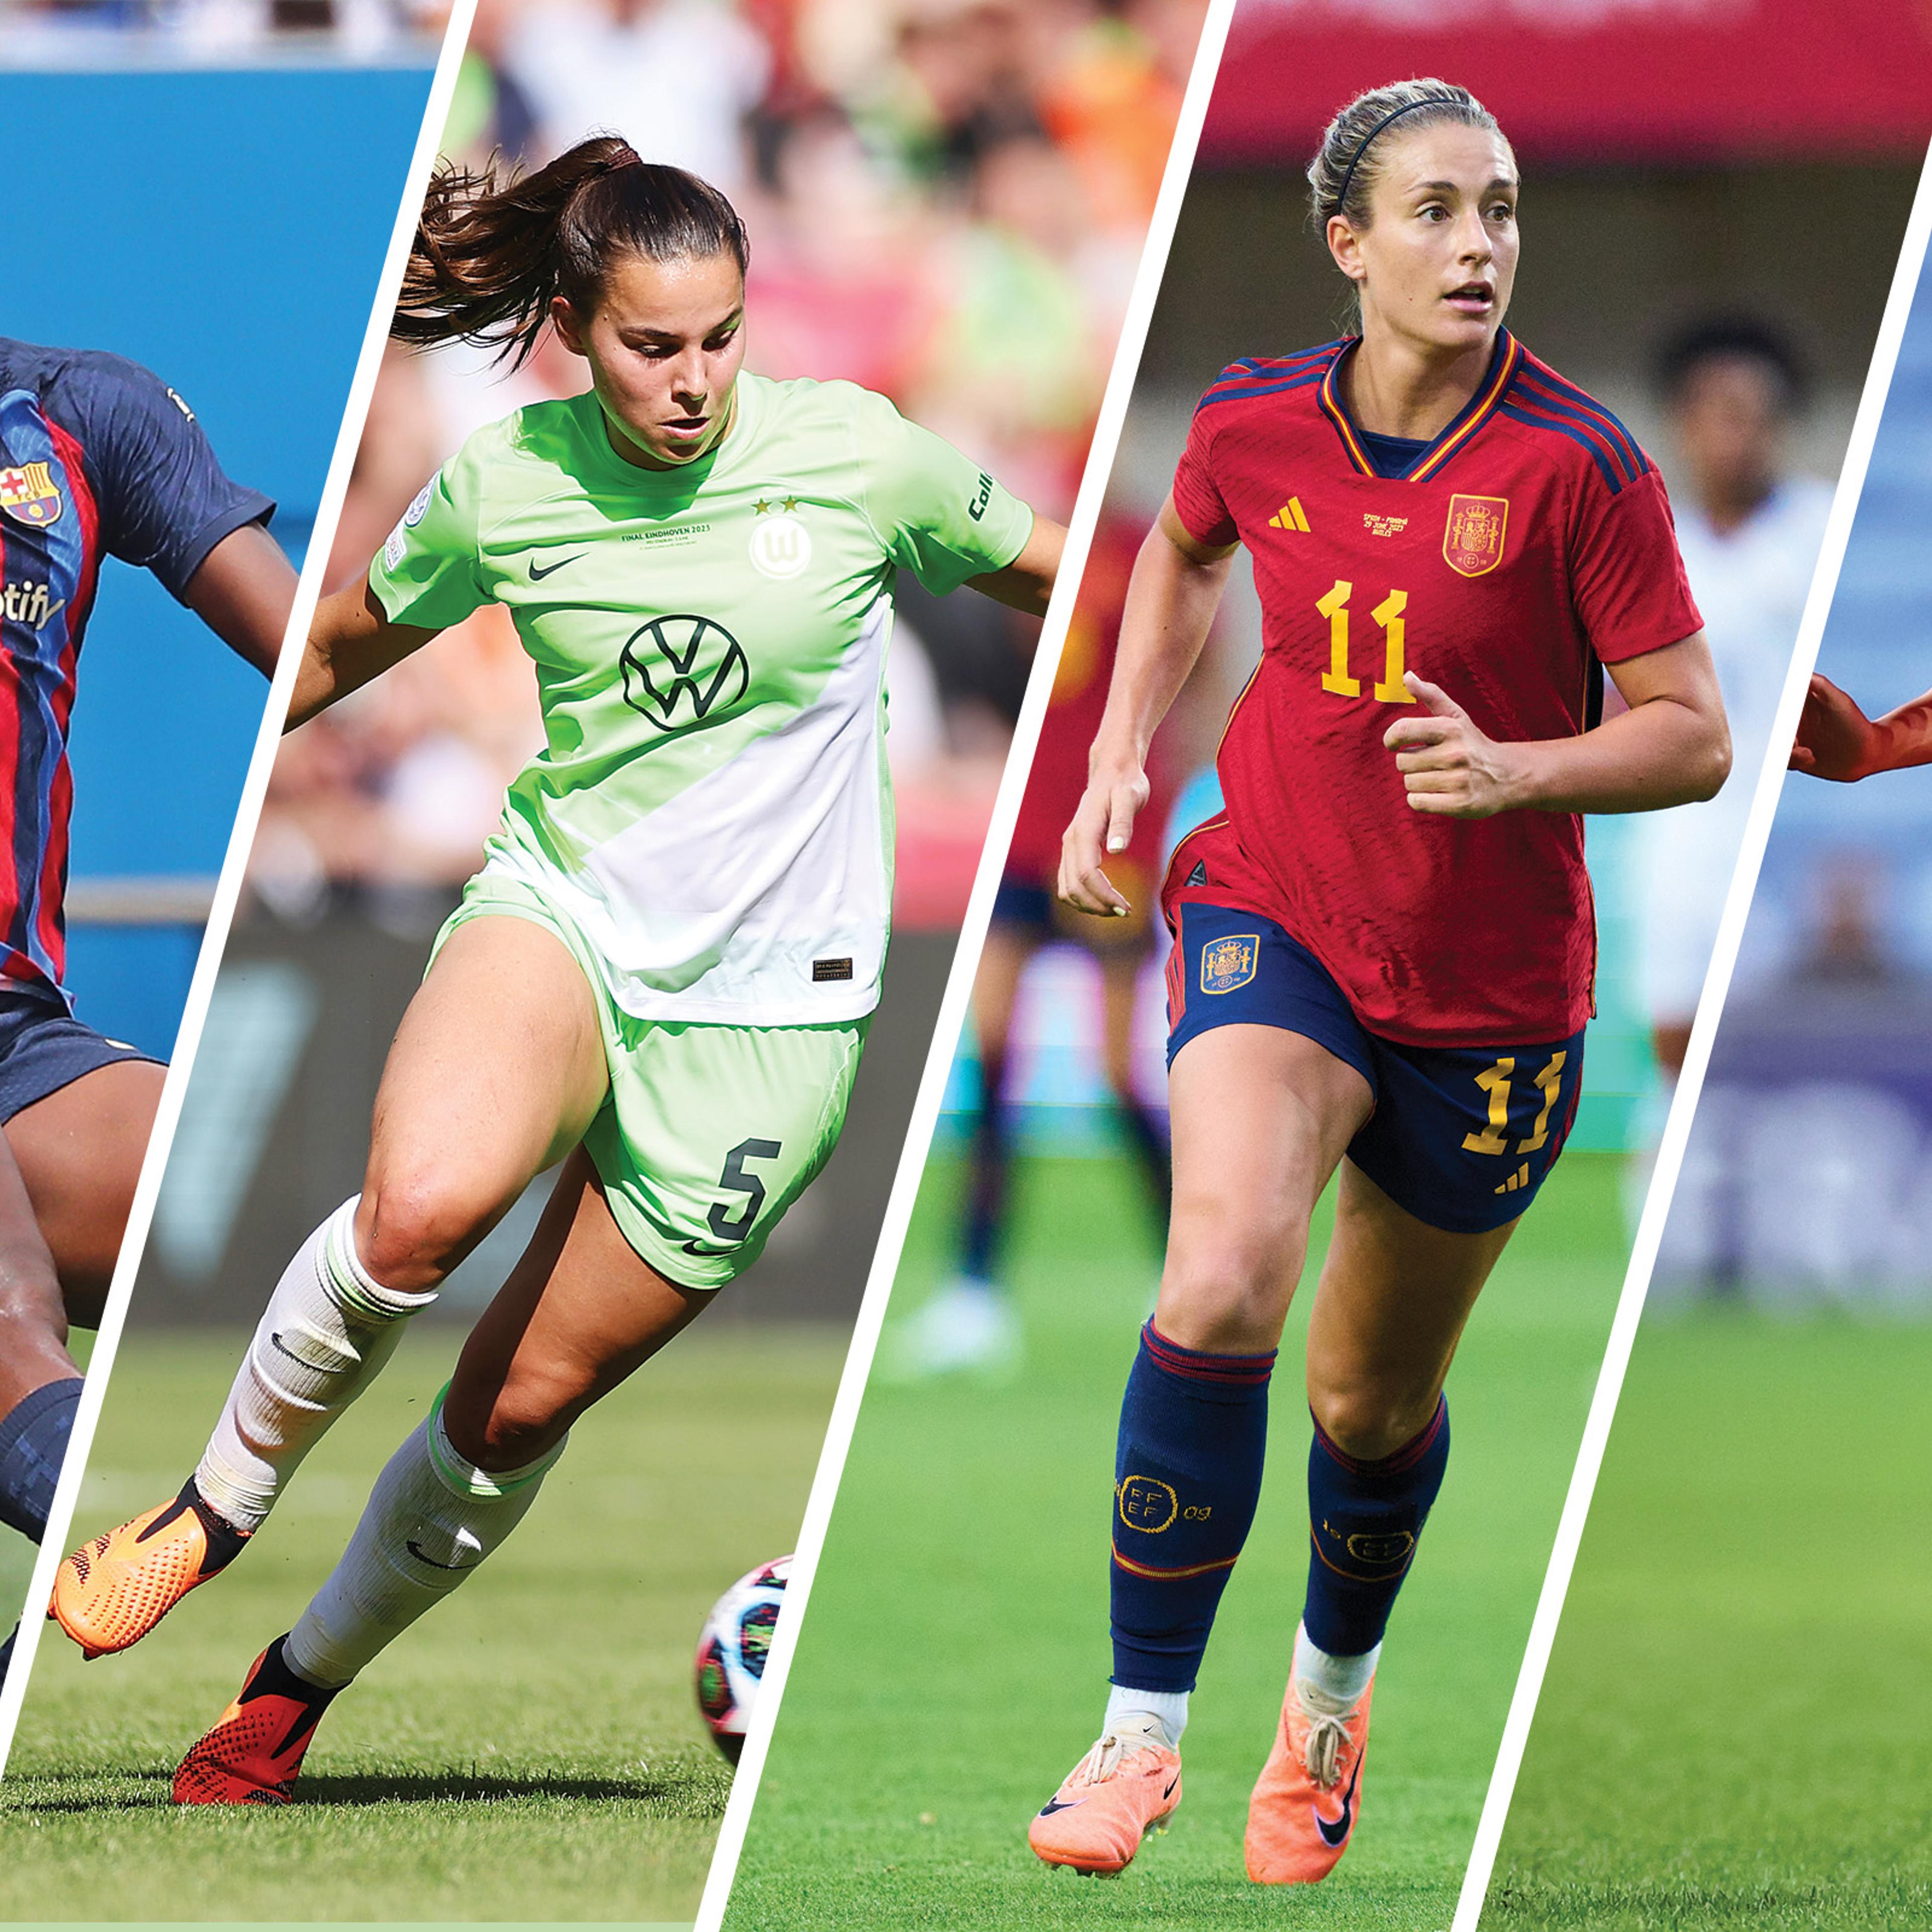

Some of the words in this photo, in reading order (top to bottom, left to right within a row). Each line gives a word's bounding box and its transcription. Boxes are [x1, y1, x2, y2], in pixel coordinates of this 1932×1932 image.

[621, 533, 643, 542] FINAL
[646, 527, 690, 539] EINDHOVEN
[691, 524, 711, 533] 2023
[0, 580, 66, 630] tify
[1315, 580, 1417, 703] 11
[1461, 1050, 1567, 1155] 11
[706, 1138, 782, 1241] 5
